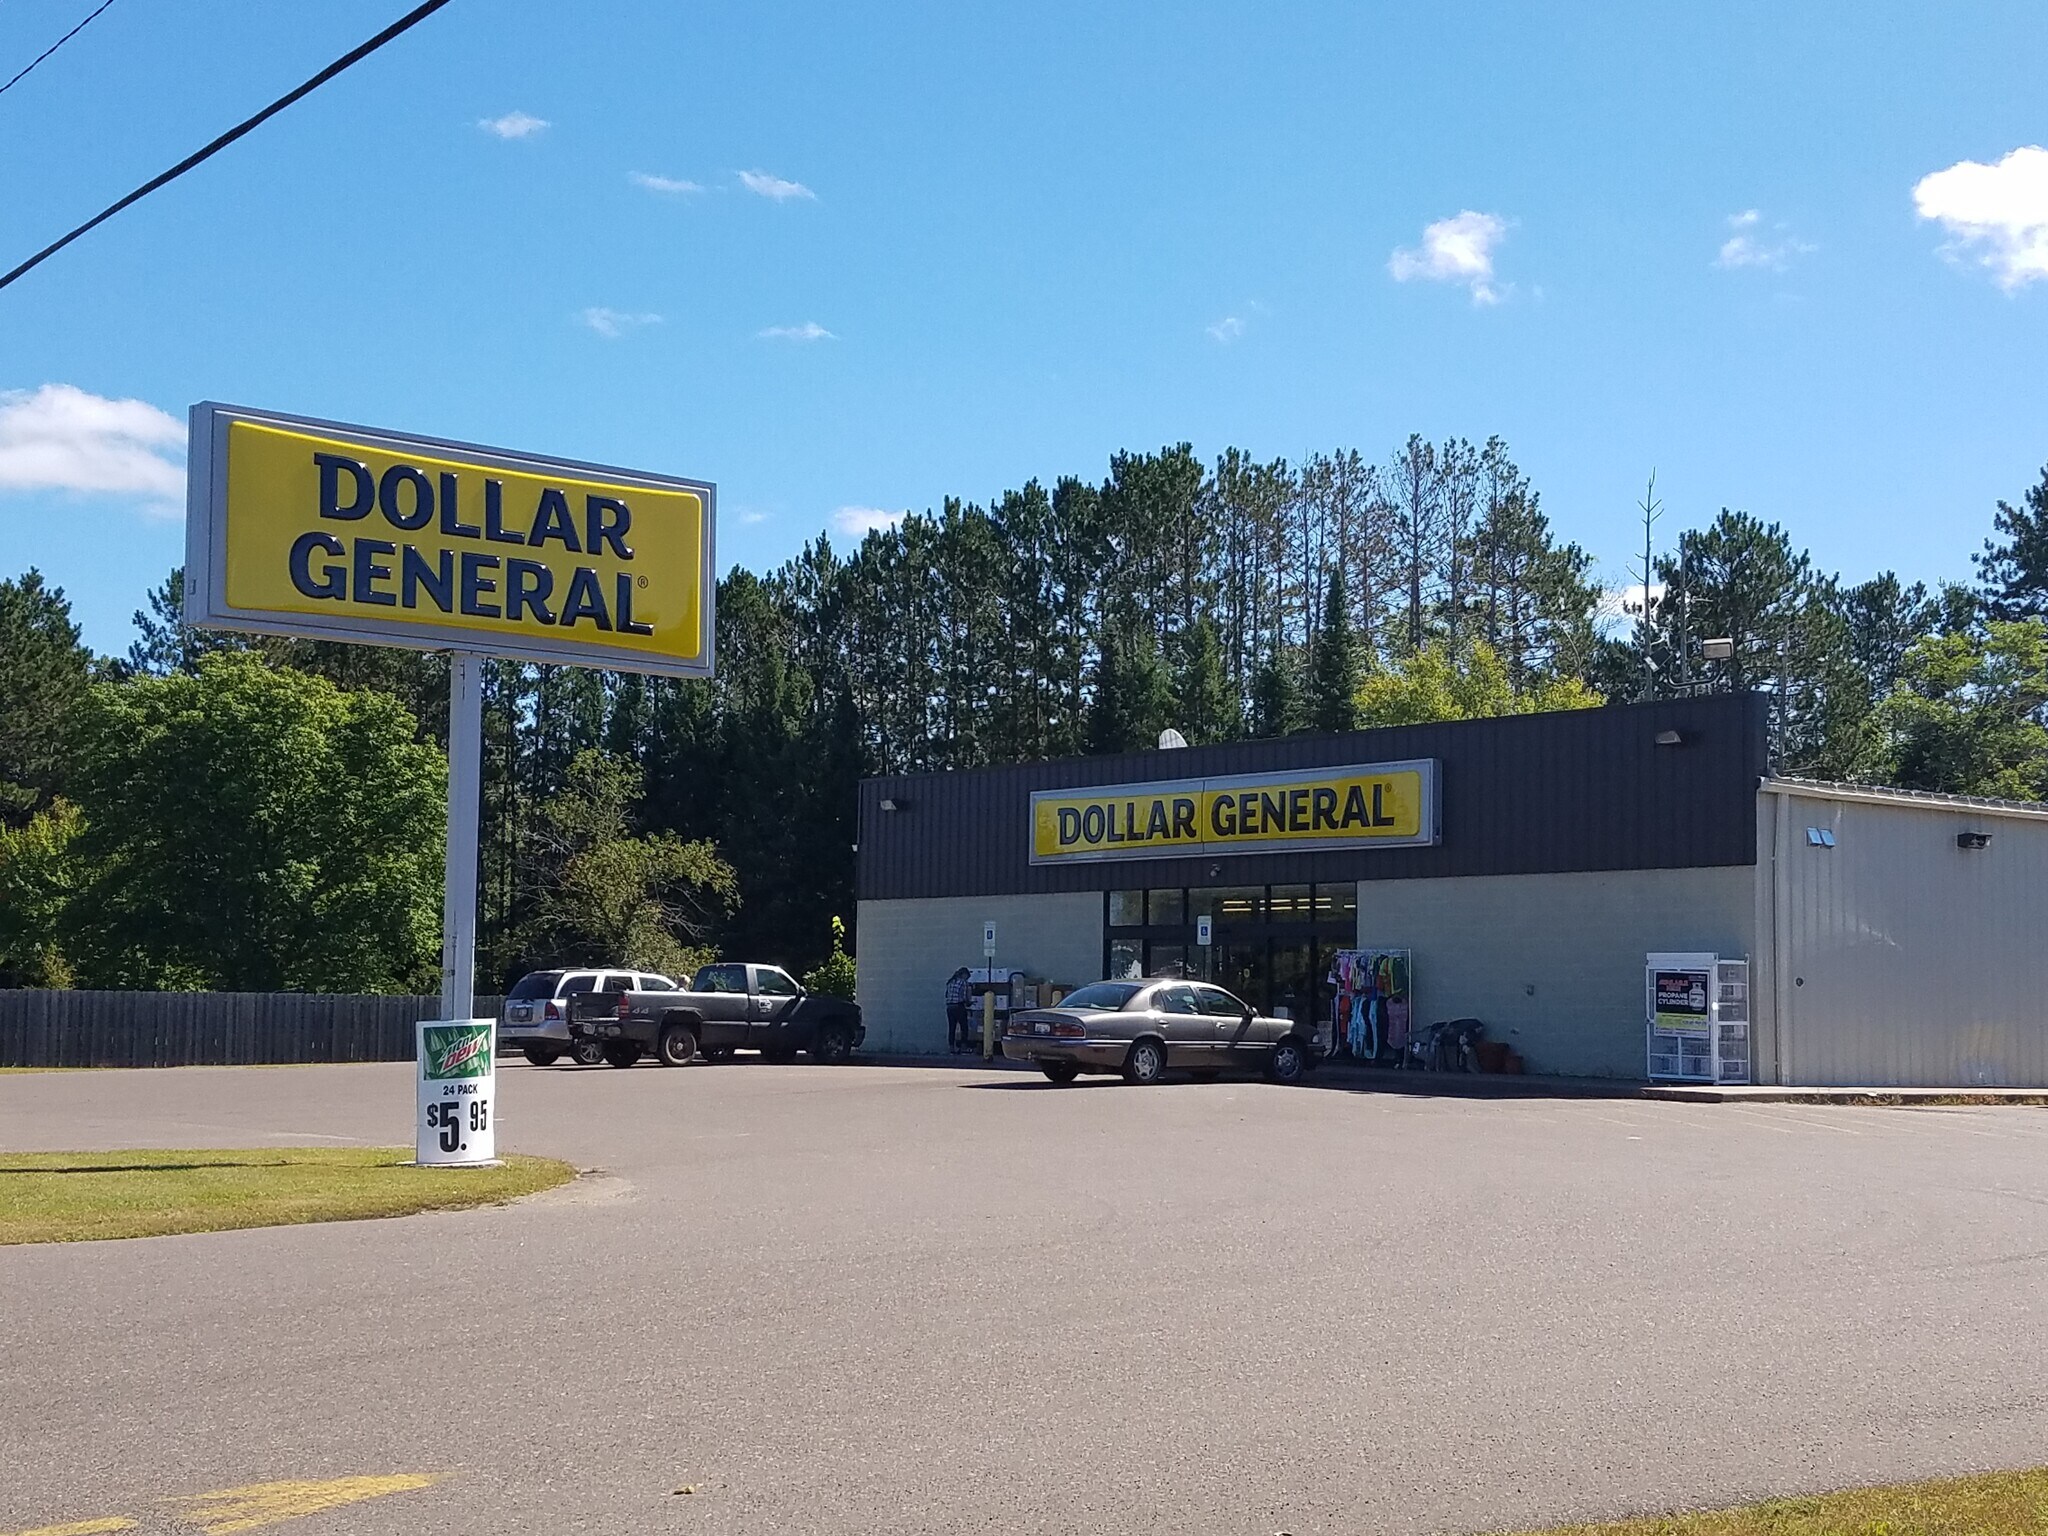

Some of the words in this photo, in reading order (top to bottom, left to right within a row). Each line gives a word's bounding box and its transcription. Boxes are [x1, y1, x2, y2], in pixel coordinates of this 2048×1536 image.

[313, 452, 634, 560] DOLLAR
[1057, 798, 1197, 845] DOLLAR
[1658, 991, 1688, 999] PROPANE
[1658, 998, 1689, 1006] CYLINDER
[443, 1085, 455, 1095] 24
[458, 1084, 478, 1095] PACK
